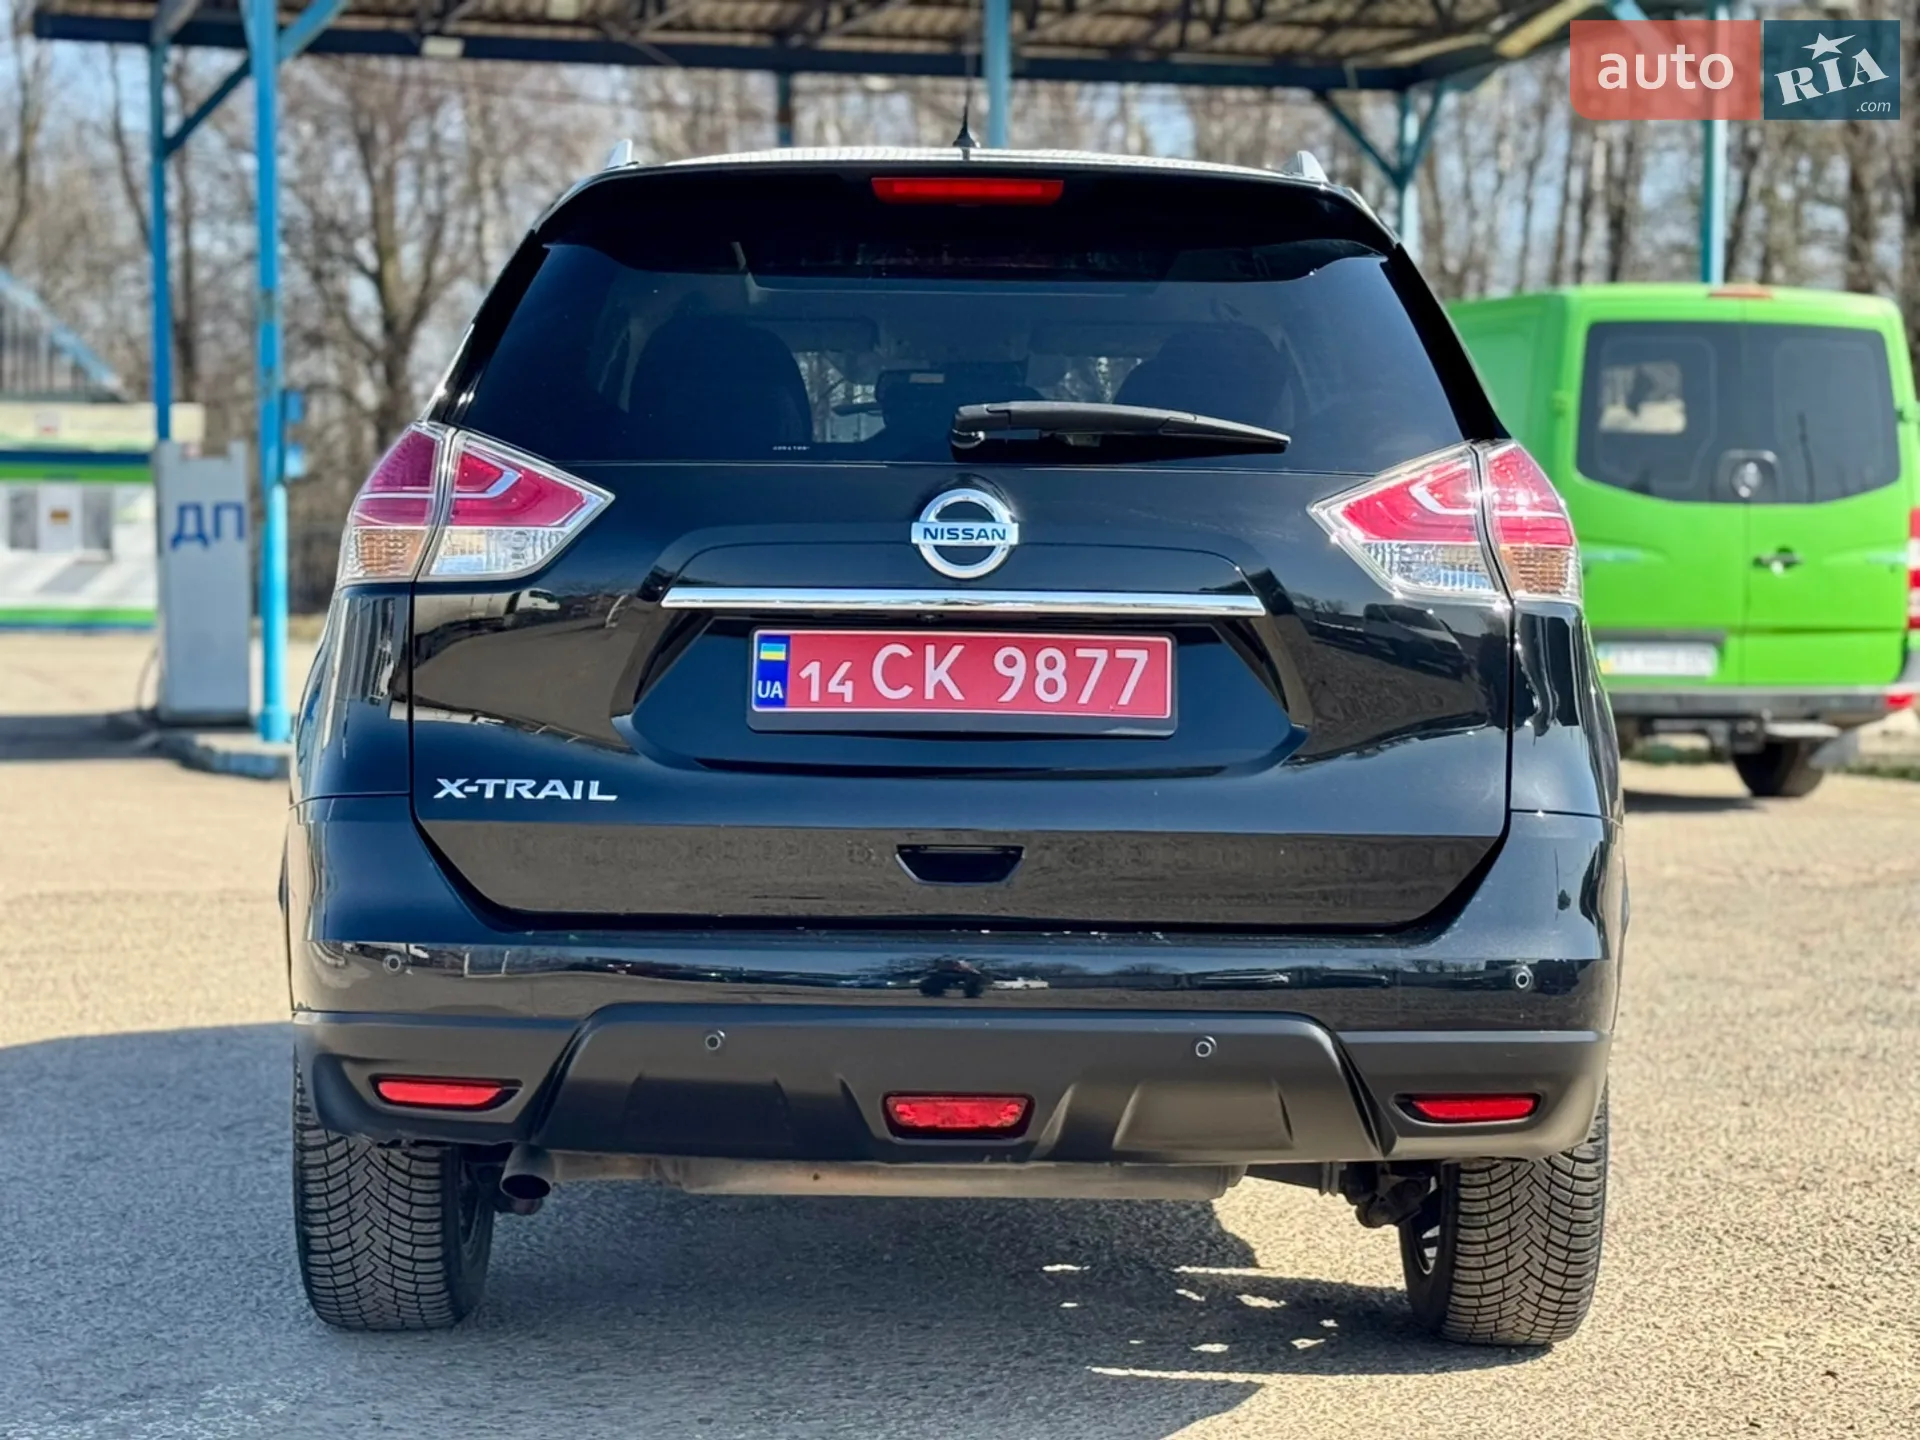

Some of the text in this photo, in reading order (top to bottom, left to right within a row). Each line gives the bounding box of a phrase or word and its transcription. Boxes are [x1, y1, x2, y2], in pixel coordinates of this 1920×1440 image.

[170, 501, 245, 551] ДП
[923, 527, 1007, 541] NISSAN
[799, 643, 1149, 706] 14 CK 9877
[757, 680, 784, 699] UA
[433, 778, 618, 801] X-TRAIL
